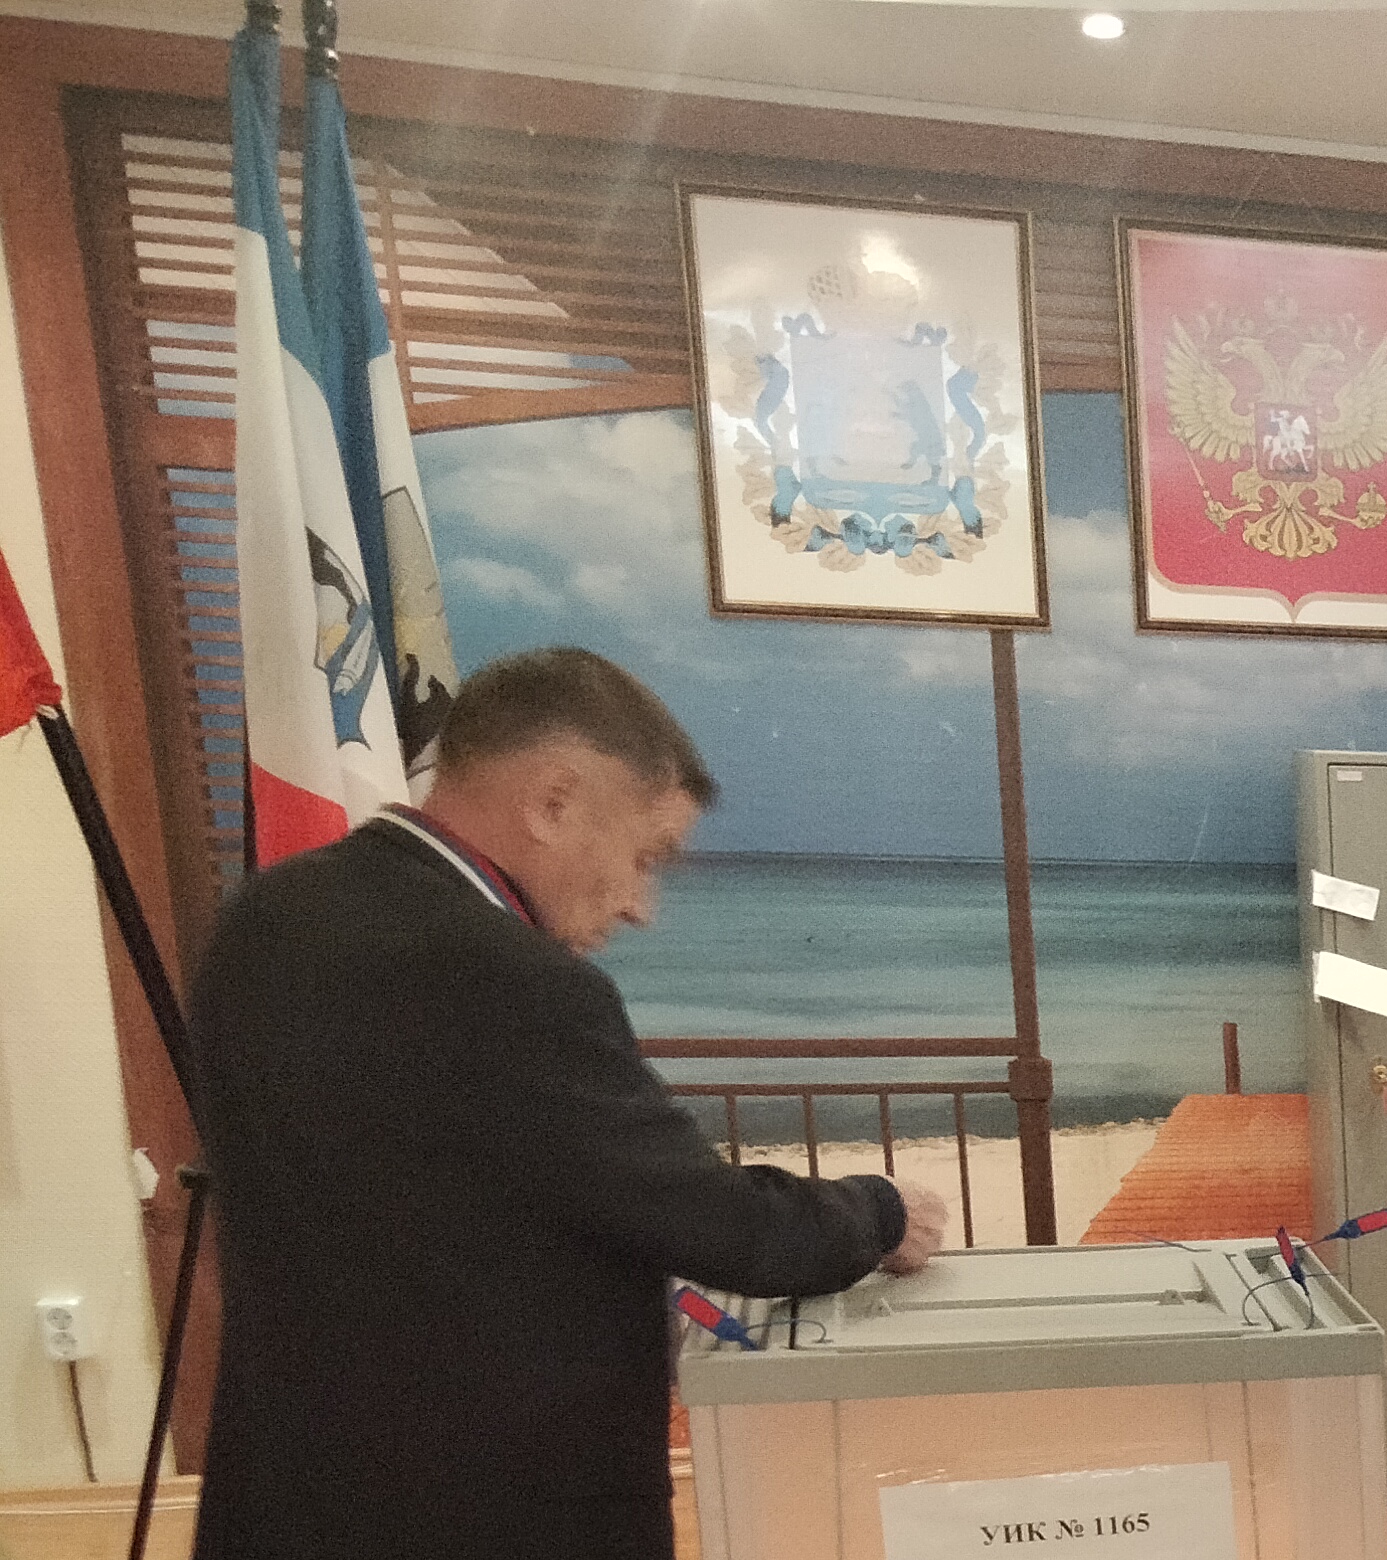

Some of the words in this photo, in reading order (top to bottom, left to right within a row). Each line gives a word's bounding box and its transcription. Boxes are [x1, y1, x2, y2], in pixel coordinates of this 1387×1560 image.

[980, 1521, 1047, 1546] УИК
[1055, 1518, 1084, 1540] №
[1095, 1512, 1151, 1536] 1165
